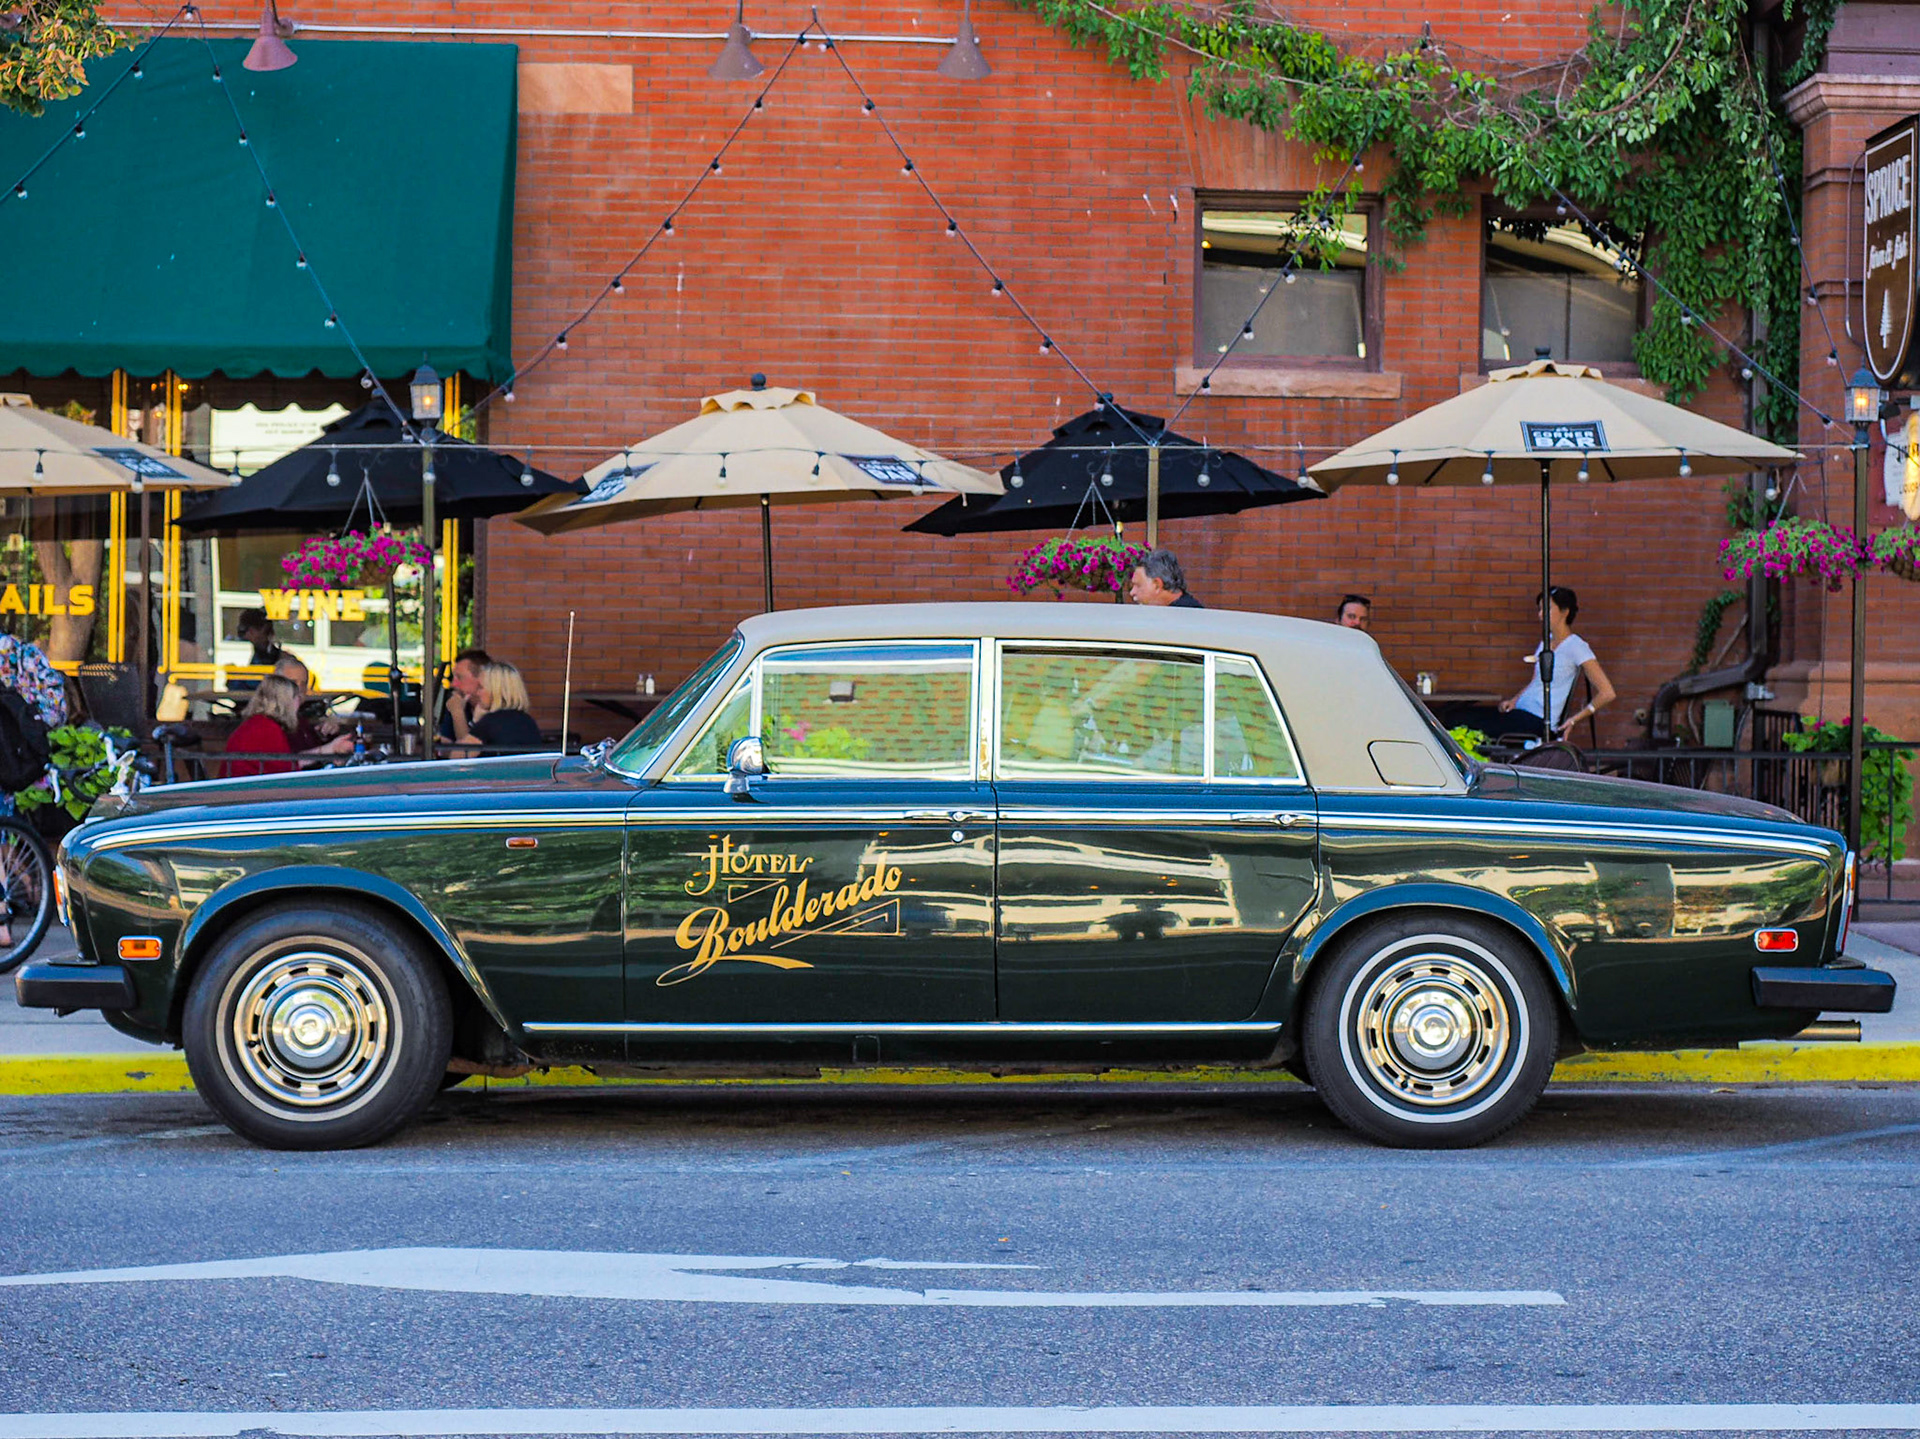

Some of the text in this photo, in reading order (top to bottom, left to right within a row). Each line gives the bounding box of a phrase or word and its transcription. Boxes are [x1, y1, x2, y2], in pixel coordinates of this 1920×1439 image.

[1866, 154, 1910, 225] SPRUCE
[1535, 437, 1596, 448] BAR
[0, 583, 95, 615] AILS
[259, 588, 366, 621] WINE
[657, 851, 902, 986] Boulderado
